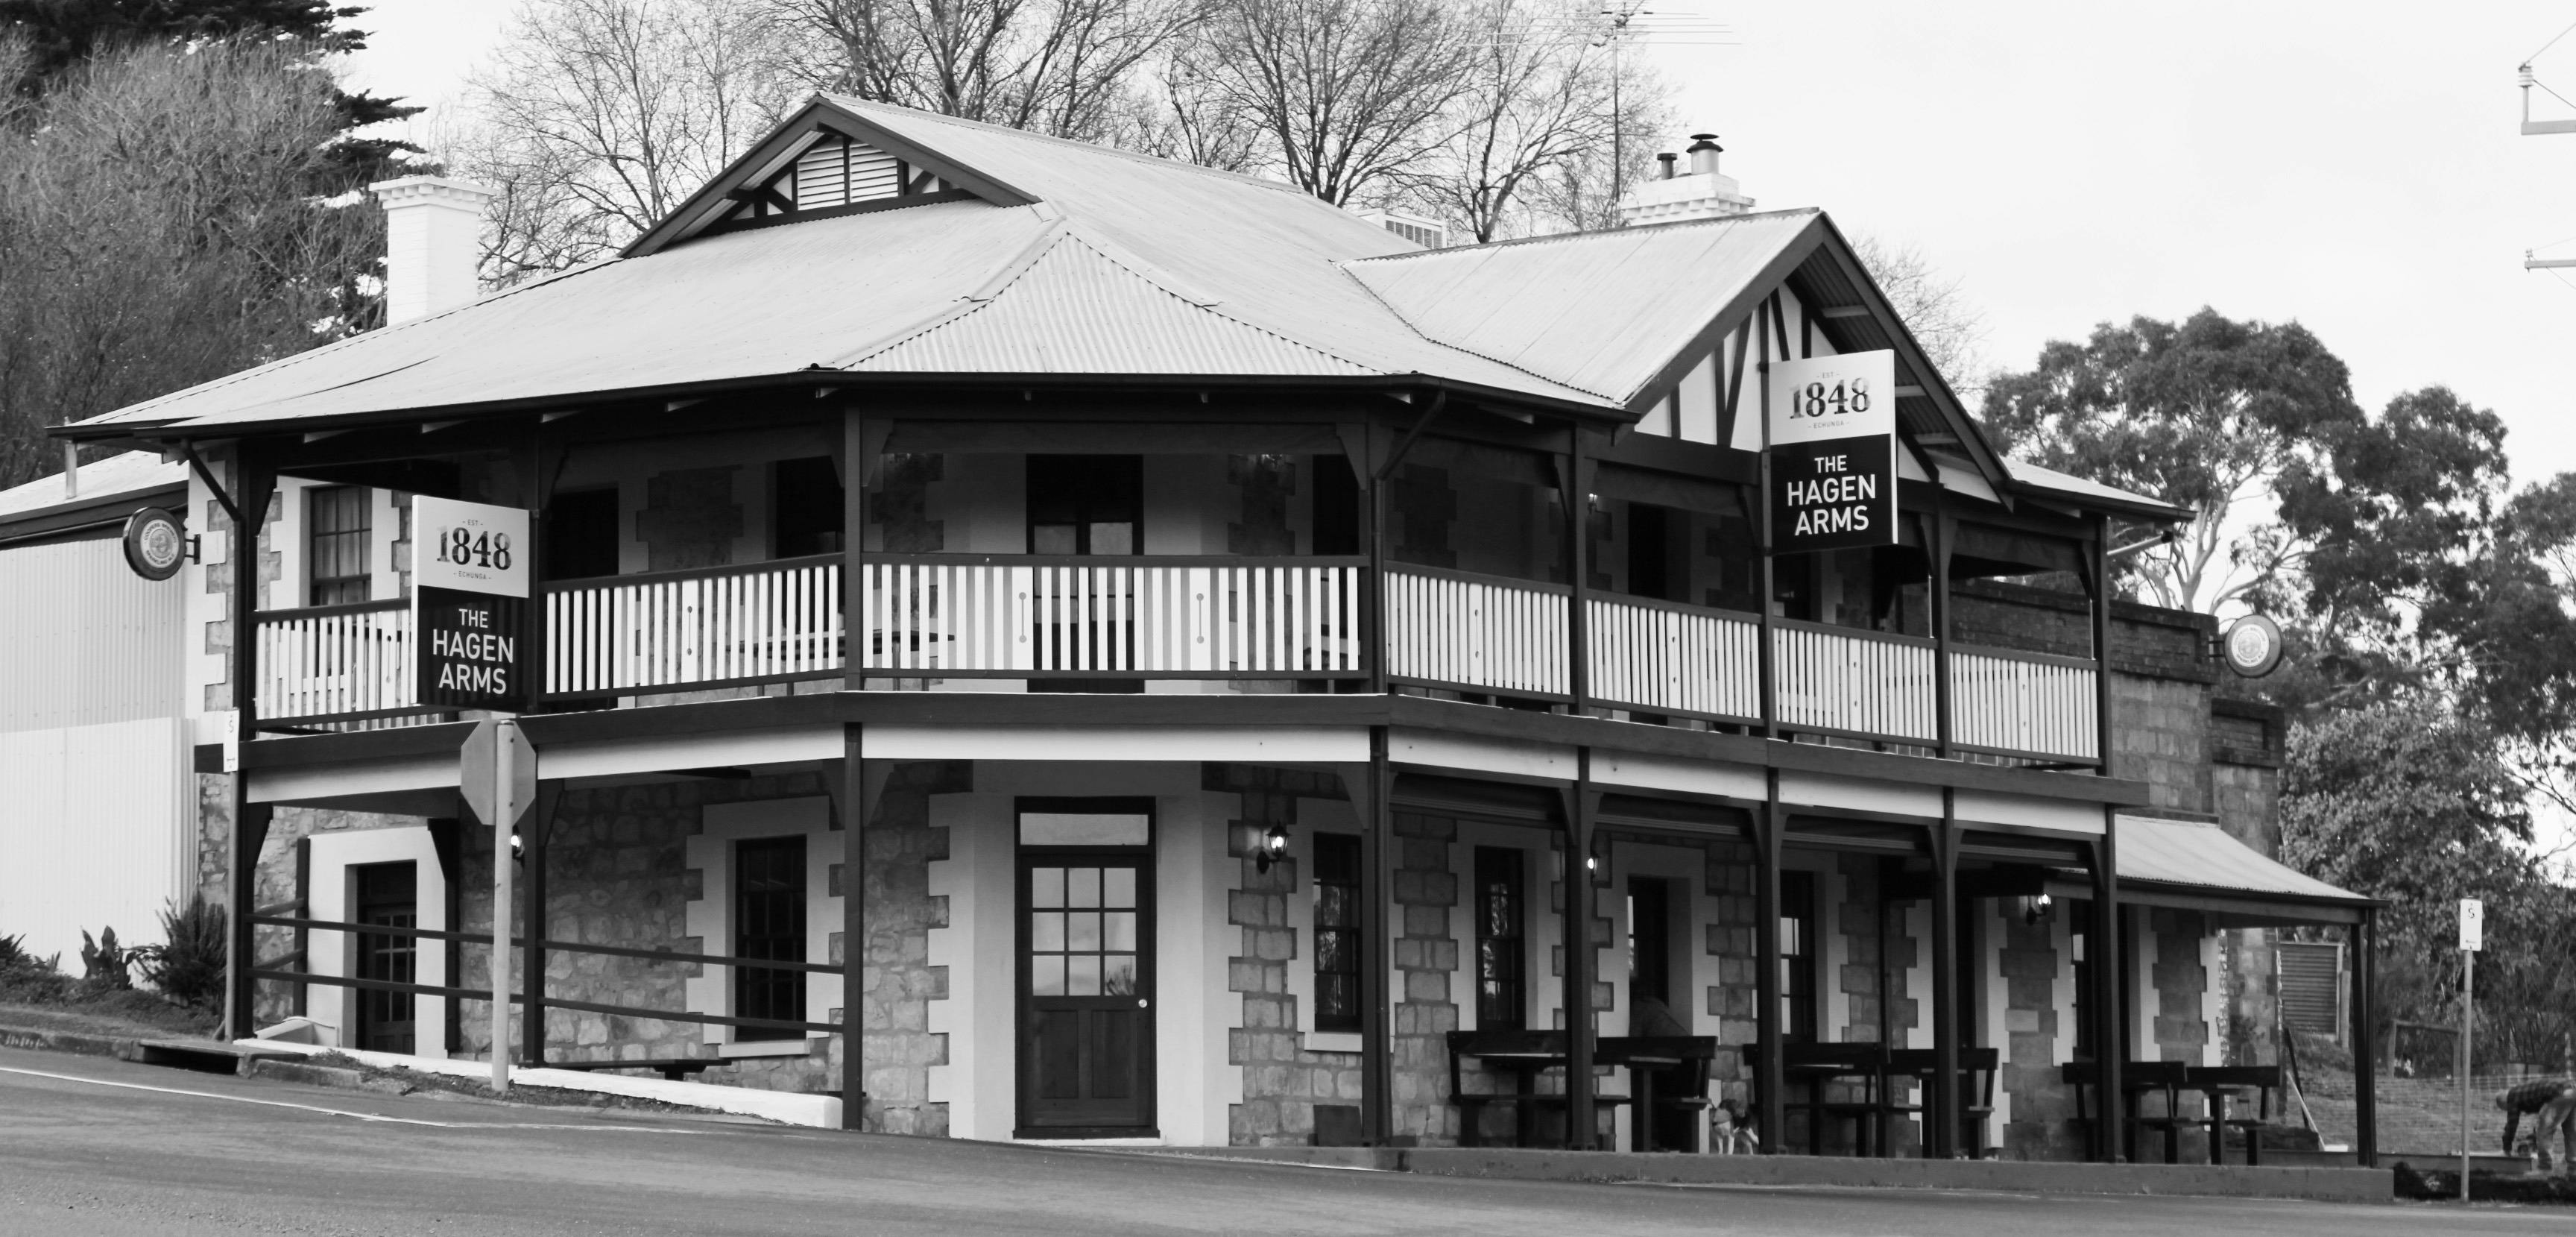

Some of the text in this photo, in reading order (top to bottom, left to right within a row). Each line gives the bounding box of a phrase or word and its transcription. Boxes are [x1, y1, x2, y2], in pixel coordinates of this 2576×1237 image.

[1790, 377, 1872, 420] 1848
[1814, 455, 1847, 473] THE
[1787, 473, 1876, 506] HAGEN
[1794, 505, 1869, 536] ARMS
[436, 526, 512, 570] 1848
[458, 608, 489, 629] THE
[432, 629, 514, 664] HAGEN
[438, 662, 507, 695] ARMS
